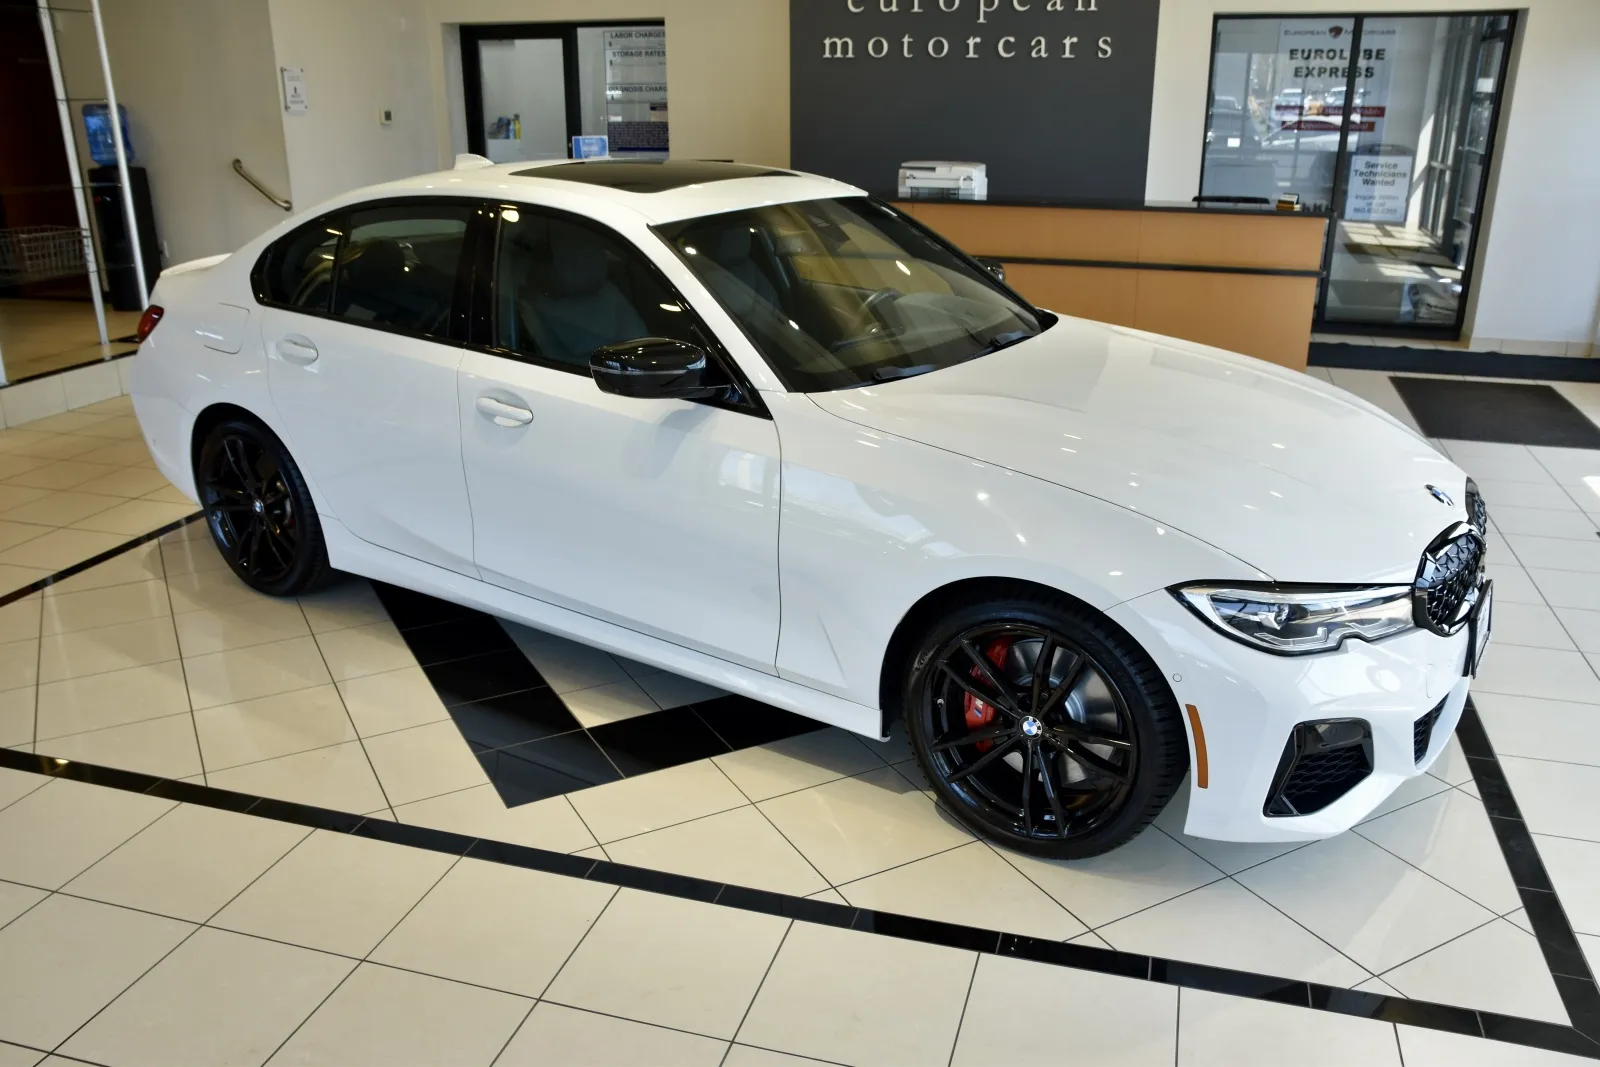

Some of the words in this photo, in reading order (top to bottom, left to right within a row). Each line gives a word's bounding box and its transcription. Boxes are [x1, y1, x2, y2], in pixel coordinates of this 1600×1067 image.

[822, 33, 1113, 58] motorcars
[1289, 48, 1386, 60] EUROLBE
[1364, 161, 1398, 169] Service
[1354, 170, 1408, 178] Technicians
